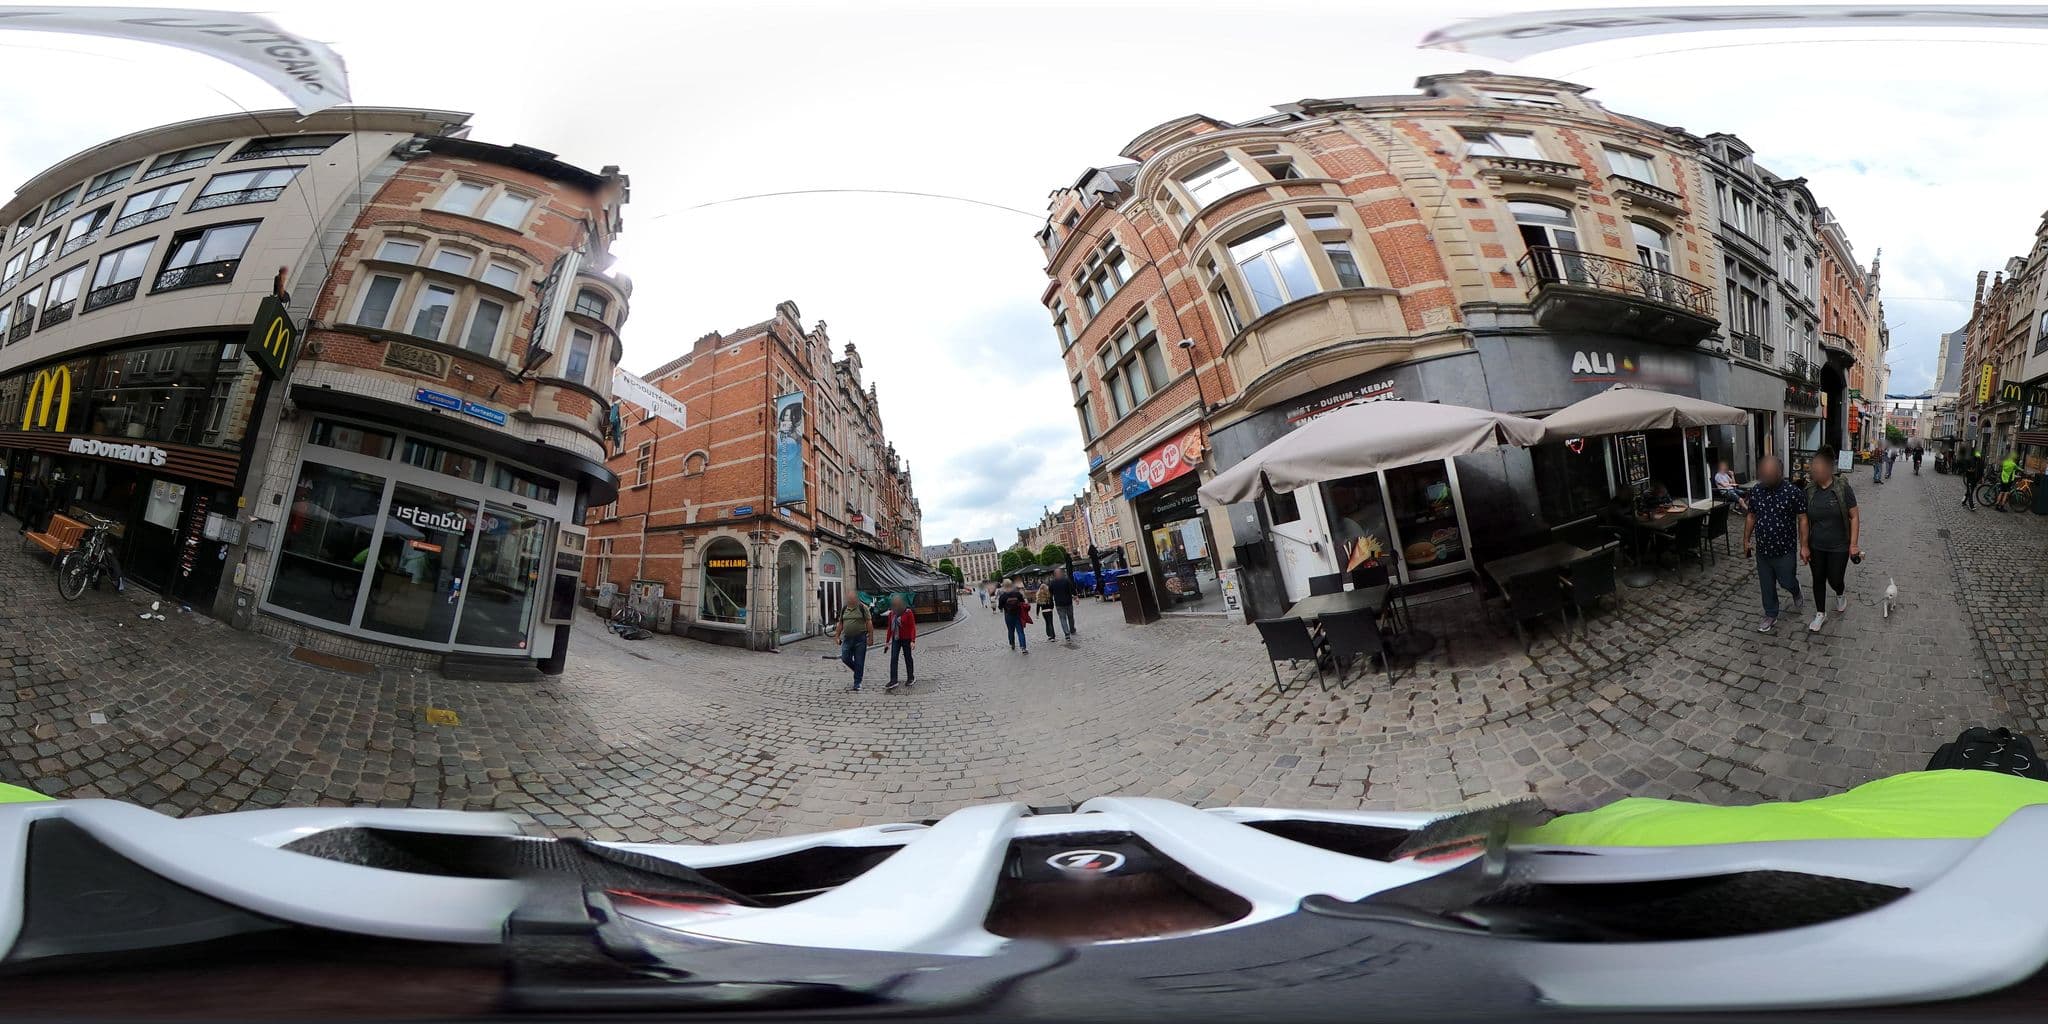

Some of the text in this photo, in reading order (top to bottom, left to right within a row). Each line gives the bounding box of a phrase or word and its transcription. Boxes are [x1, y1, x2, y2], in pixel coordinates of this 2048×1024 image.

[1571, 350, 1616, 375] ALI
[1361, 380, 1395, 395] KEBAP
[68, 437, 168, 466] McDonald's
[708, 559, 747, 568] SNACKLAND
